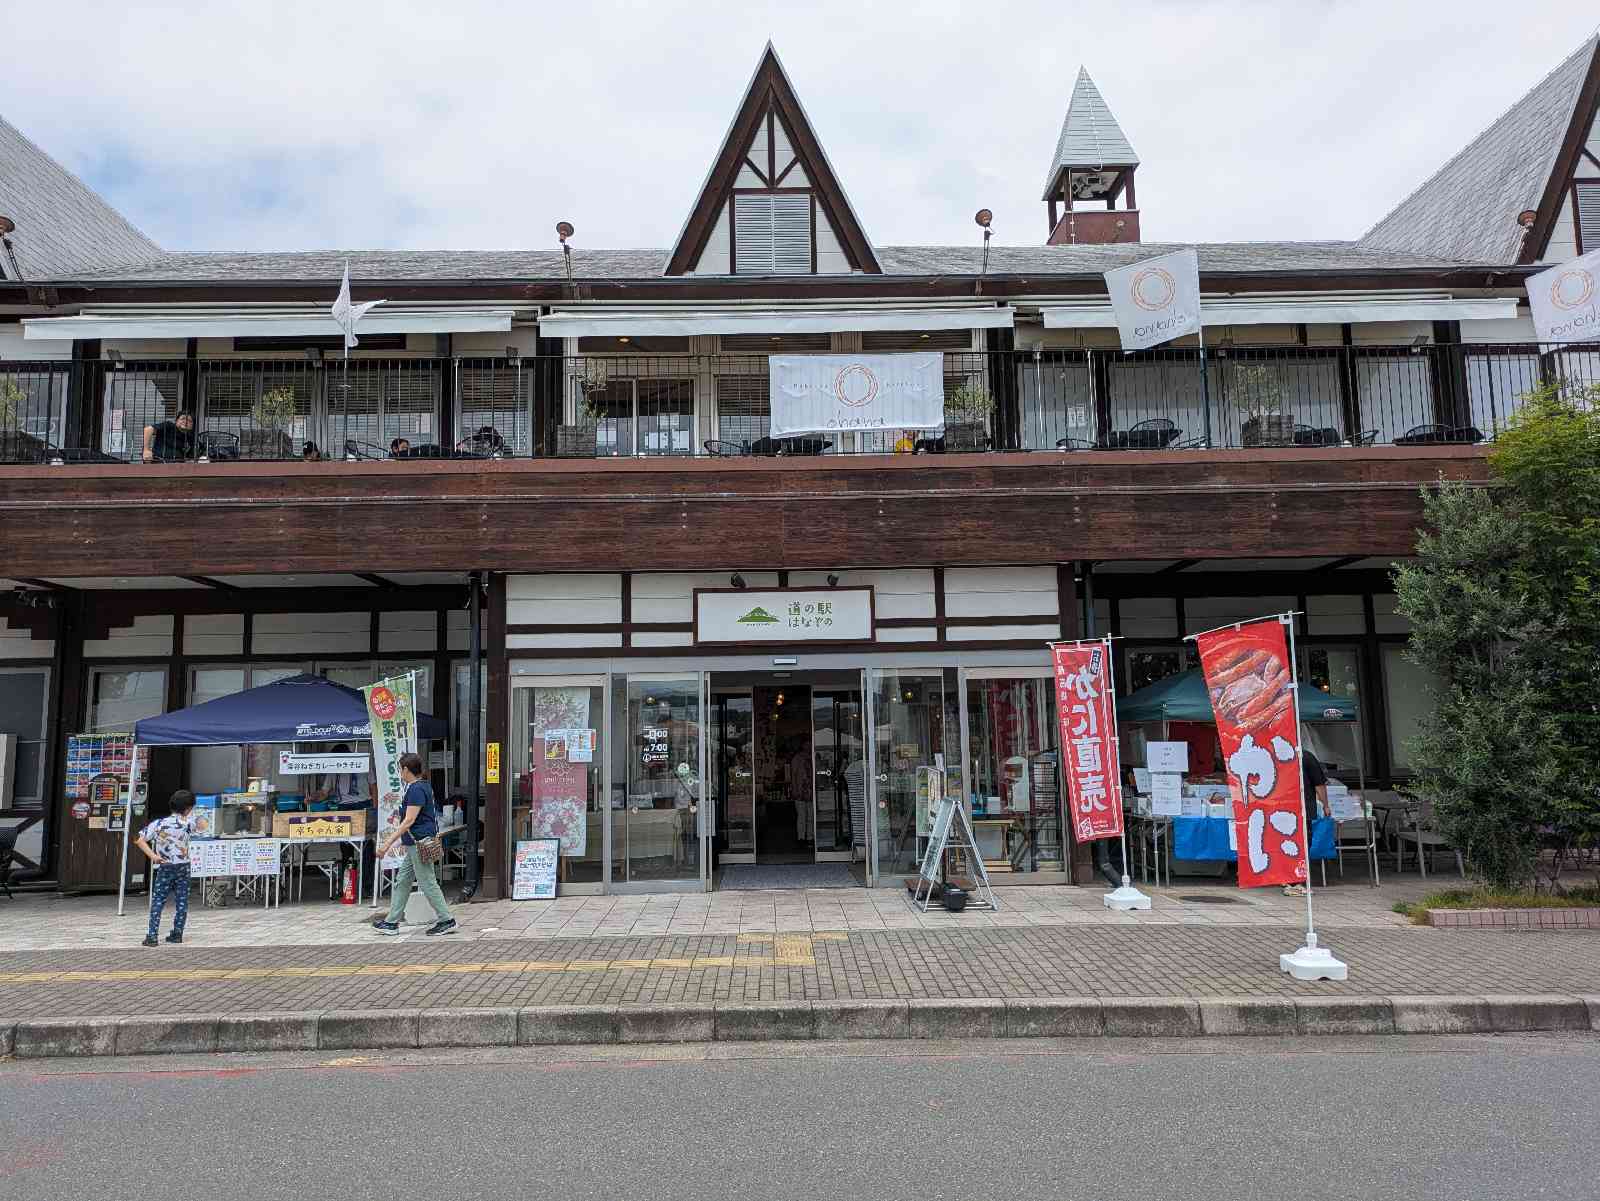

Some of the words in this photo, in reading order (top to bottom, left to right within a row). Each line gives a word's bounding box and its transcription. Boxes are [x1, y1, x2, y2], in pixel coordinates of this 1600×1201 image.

[787, 601, 833, 616] 道の駅
[787, 617, 833, 629] はなぞの
[1228, 734, 1299, 874] かに
